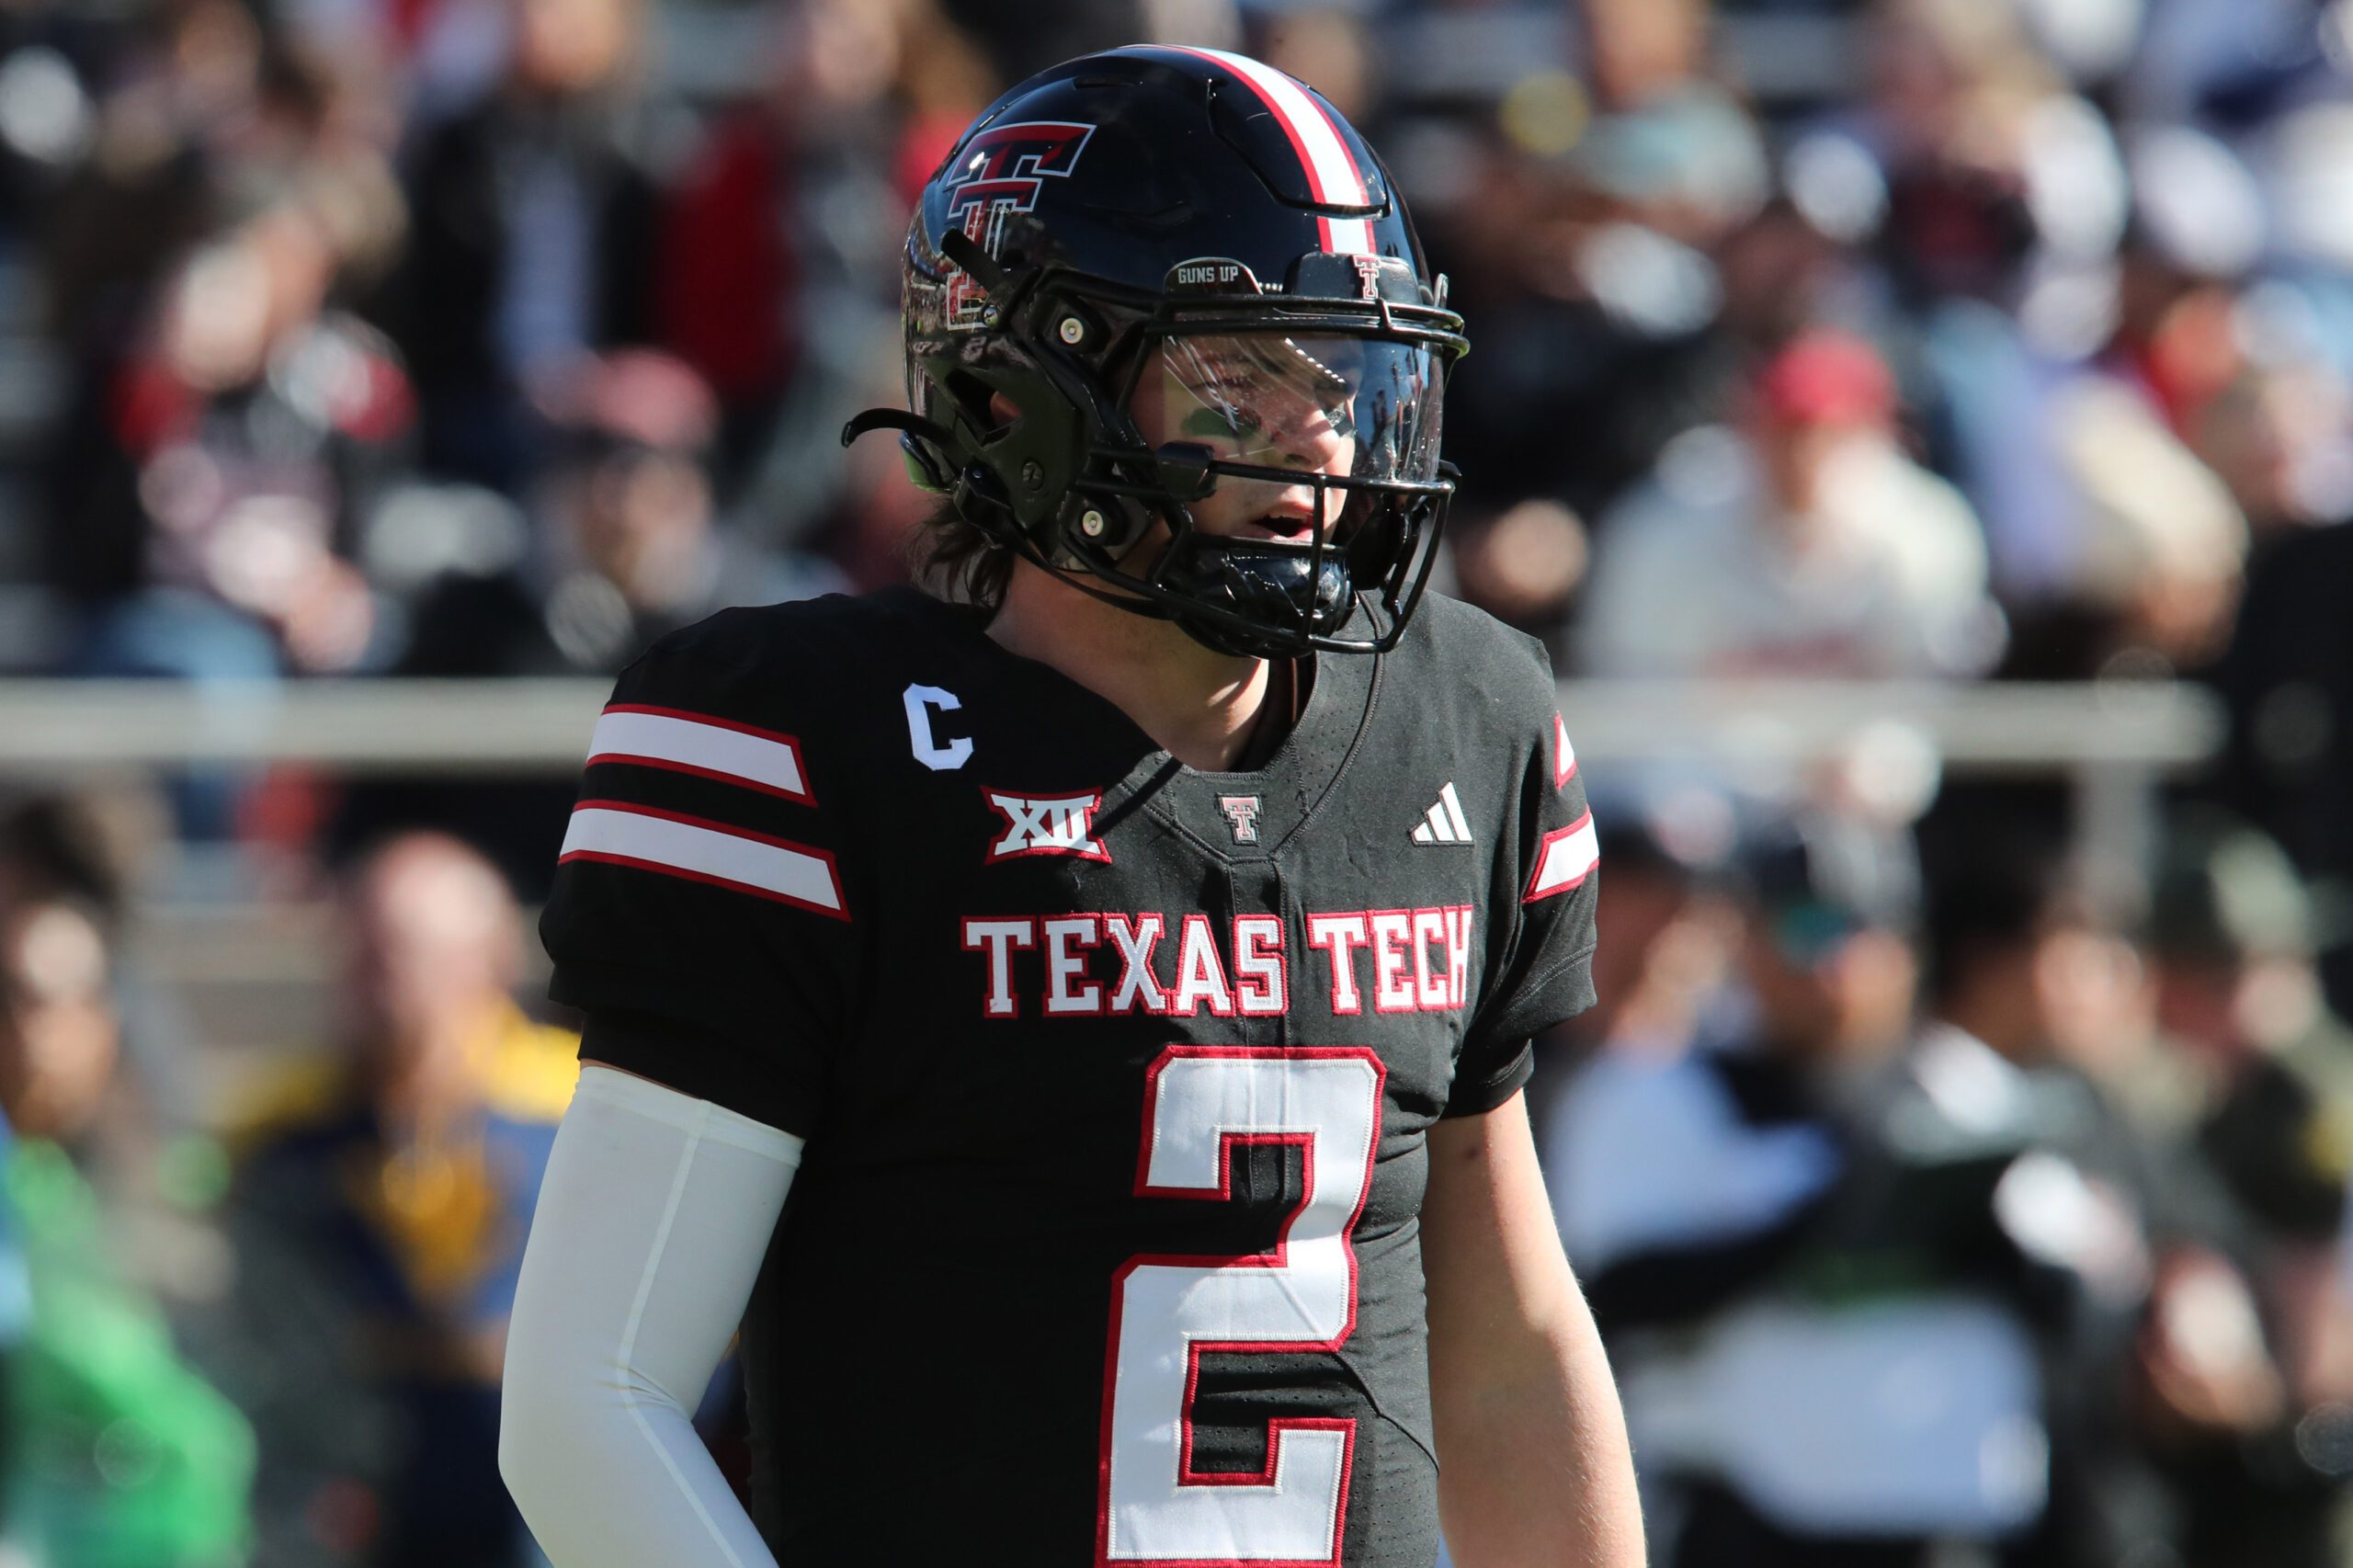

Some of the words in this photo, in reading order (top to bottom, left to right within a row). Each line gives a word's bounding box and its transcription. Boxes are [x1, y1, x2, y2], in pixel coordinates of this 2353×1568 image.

[1177, 267, 1215, 284] GUNS
[1219, 266, 1239, 282] UP
[903, 682, 974, 771] C
[961, 912, 1288, 1018] TEXAS
[1306, 905, 1472, 1017] TECH
[1095, 1045, 1388, 1568] 2
